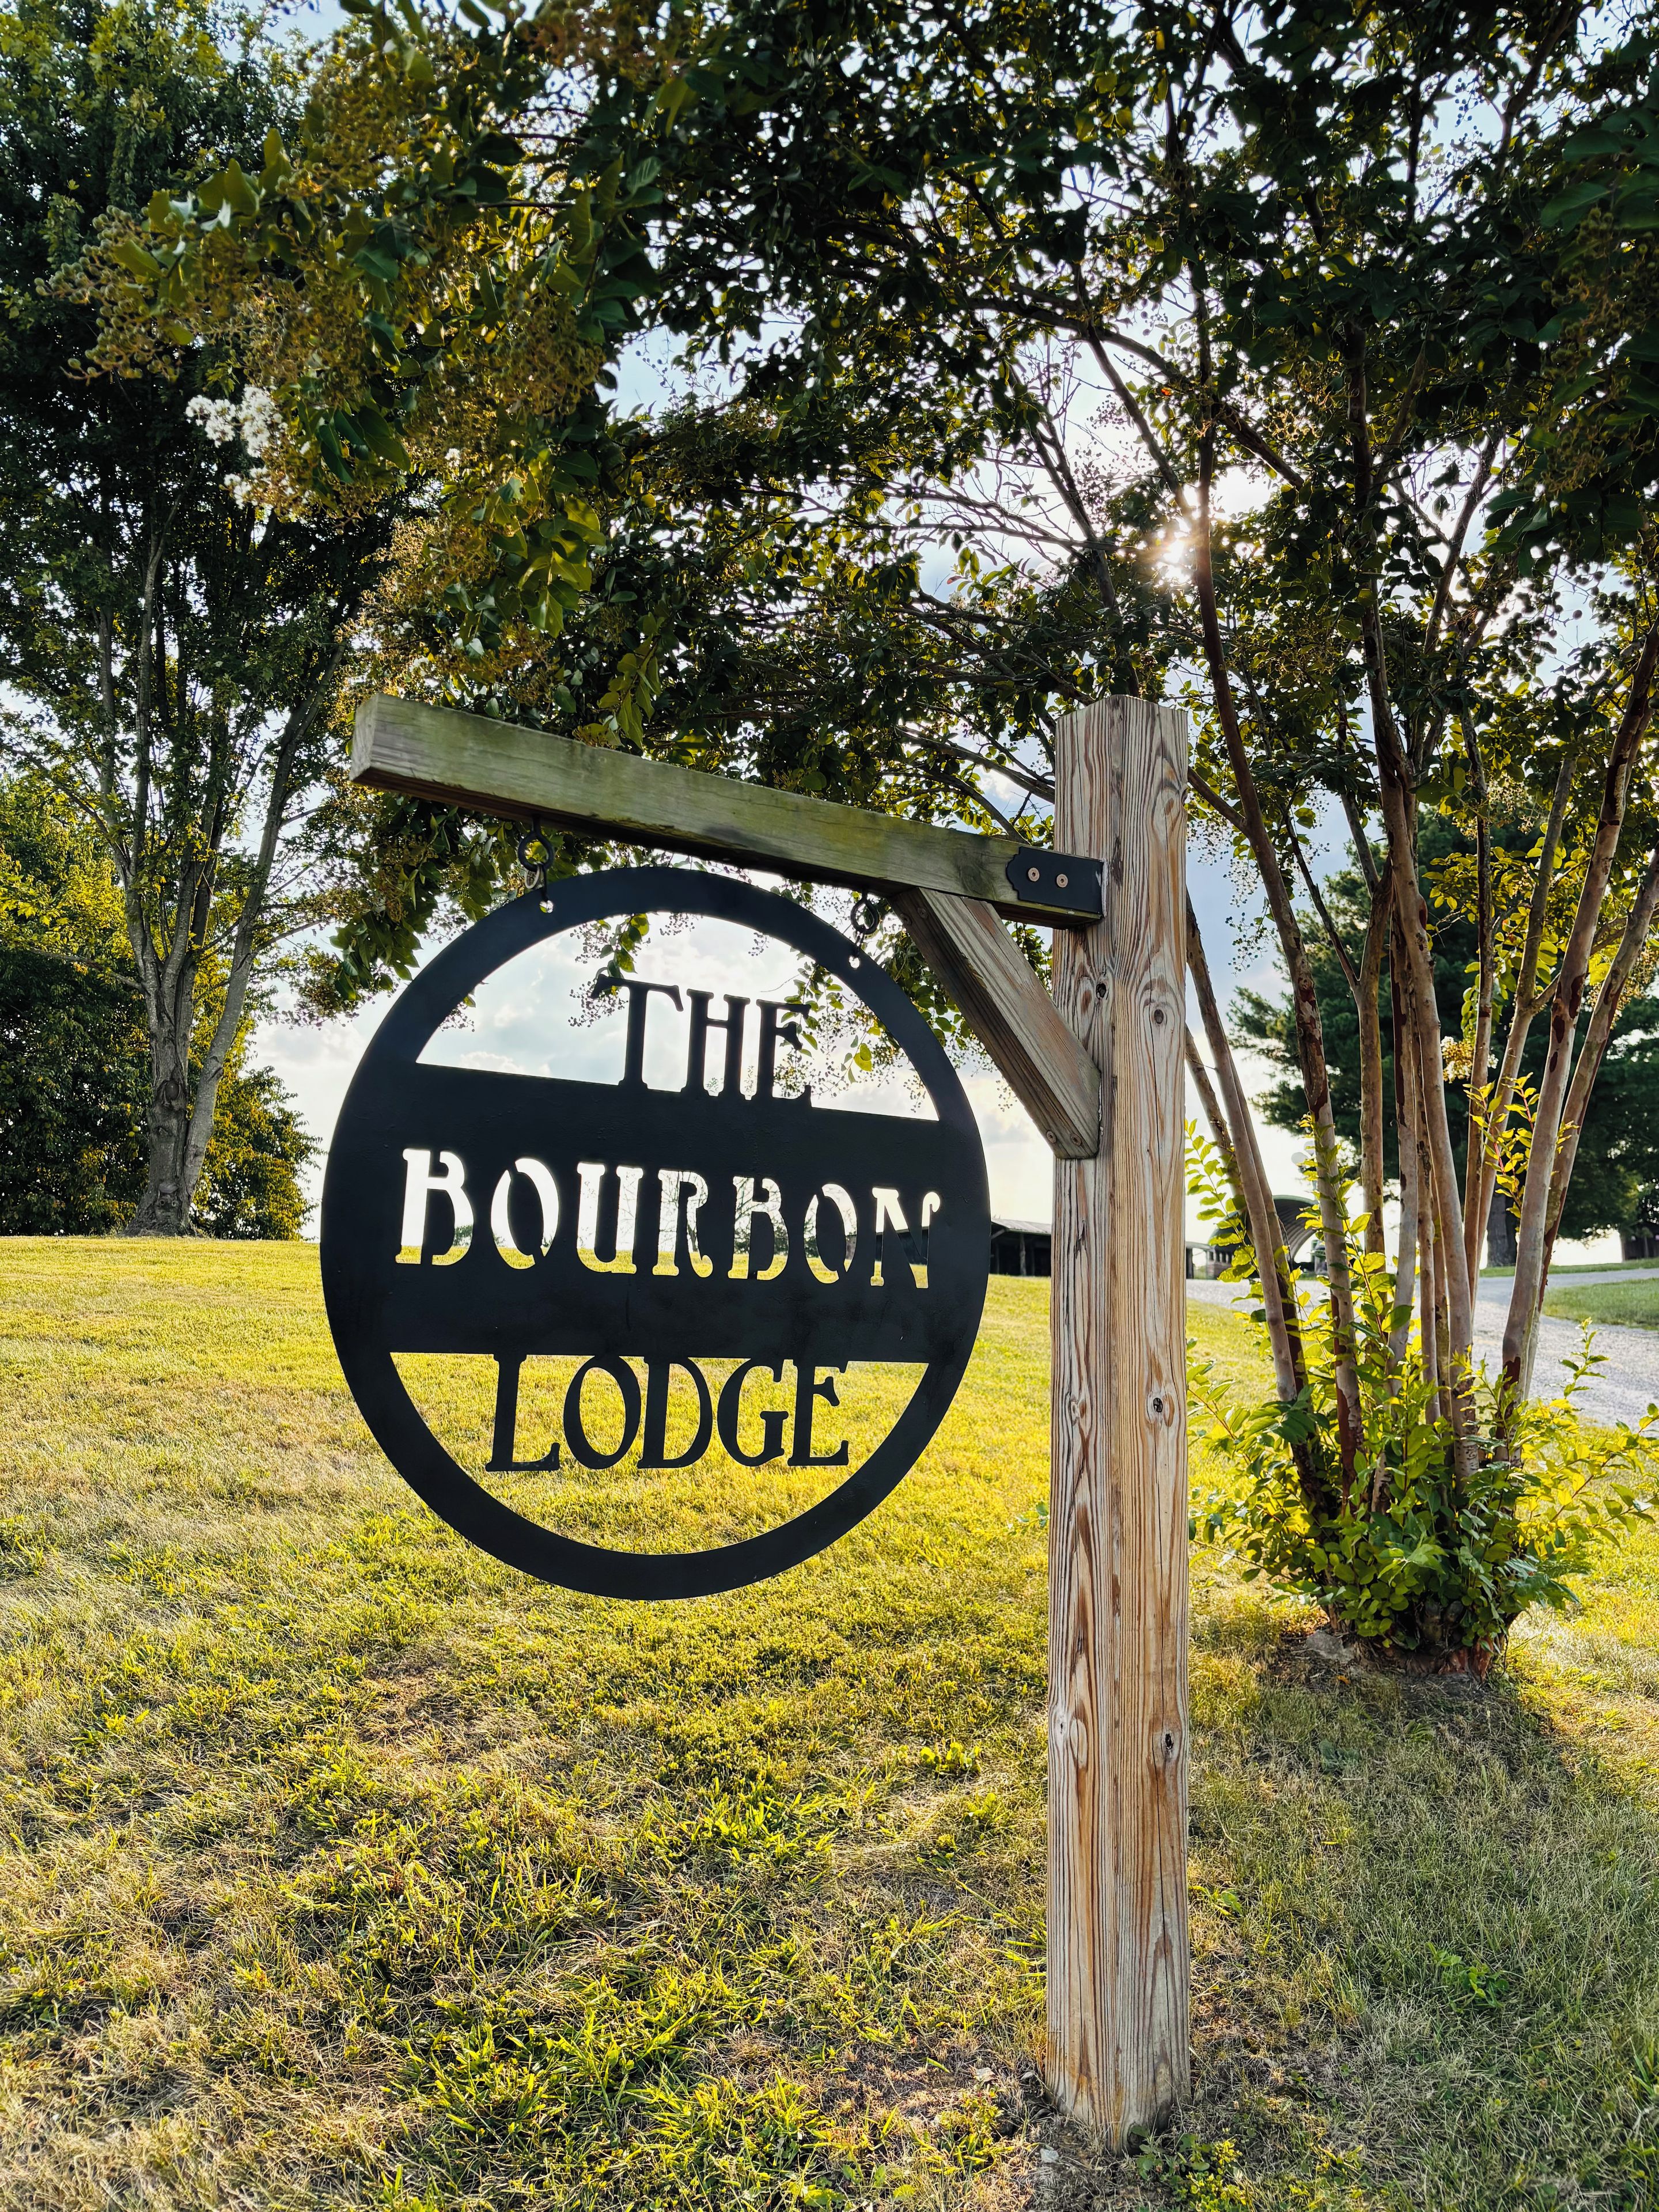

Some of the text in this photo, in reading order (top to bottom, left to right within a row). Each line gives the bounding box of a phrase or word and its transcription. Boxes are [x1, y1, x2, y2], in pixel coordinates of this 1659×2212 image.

[591, 974, 812, 1108] THE
[395, 1147, 941, 1289] BOURBON
[486, 1353, 850, 1472] LODGE
